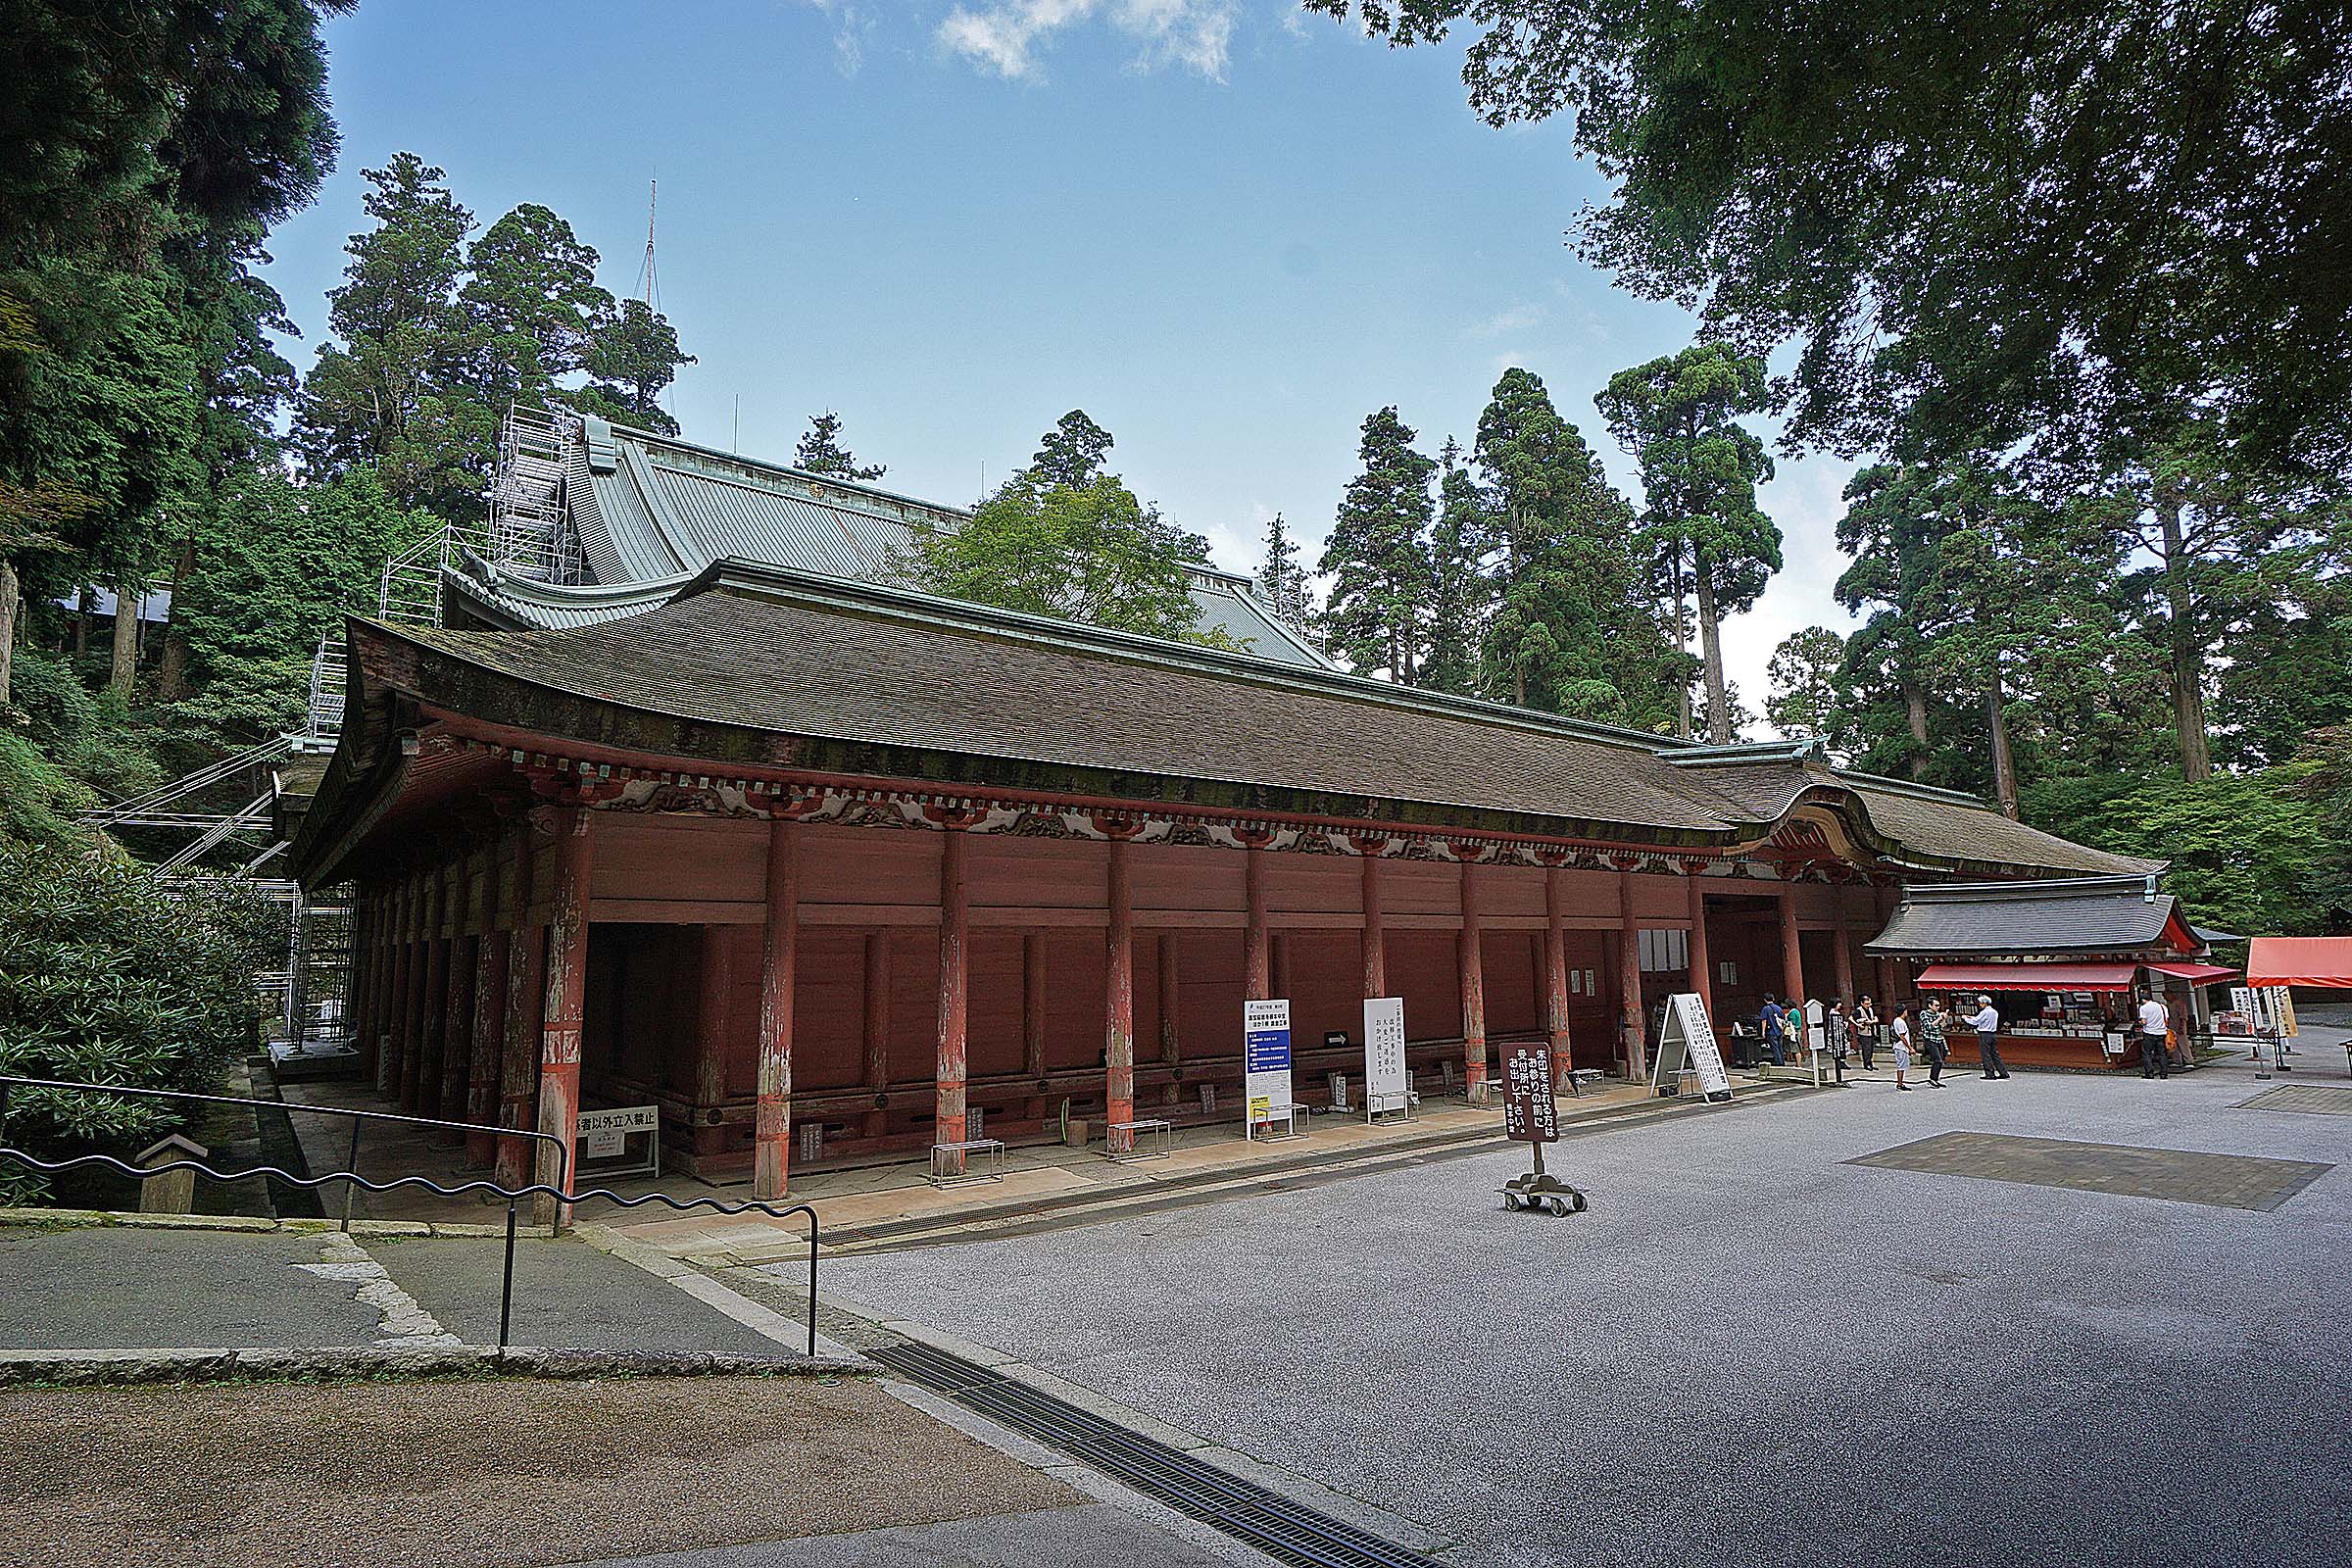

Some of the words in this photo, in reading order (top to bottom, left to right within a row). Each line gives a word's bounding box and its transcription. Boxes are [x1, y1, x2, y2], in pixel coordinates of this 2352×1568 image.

[1508, 1057, 1526, 1134] お出し下さい。
[1517, 1049, 1531, 1097] 受付所に
[1528, 1057, 1544, 1128] お参りの前に
[1536, 1049, 1555, 1138] 朱印をされる方は
